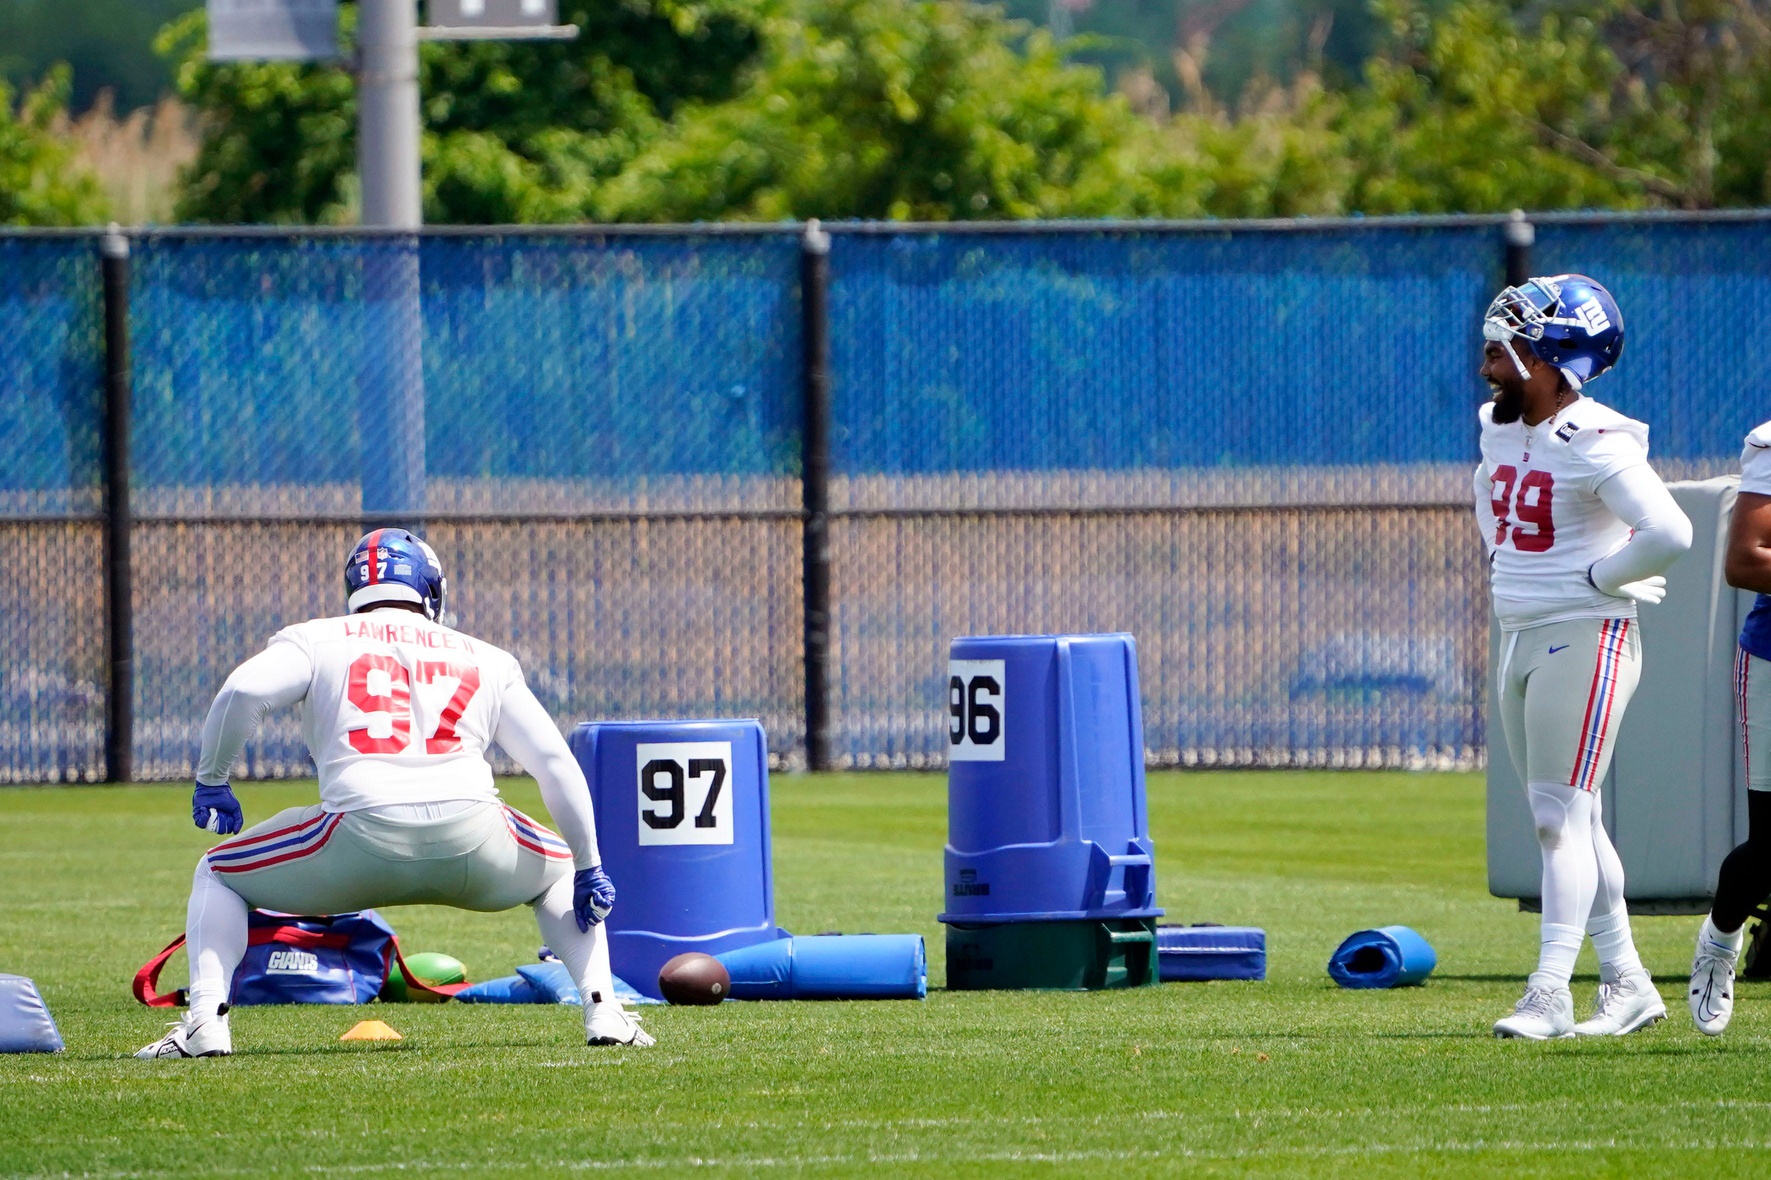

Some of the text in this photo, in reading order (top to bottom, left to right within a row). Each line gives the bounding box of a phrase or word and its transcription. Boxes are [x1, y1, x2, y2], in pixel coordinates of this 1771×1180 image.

[360, 562, 388, 581] 97
[344, 622, 457, 649] LAWRENCE
[347, 653, 480, 755] 97
[950, 675, 1001, 746] 96
[641, 758, 726, 830] 97
[268, 951, 318, 970] GIANTS
